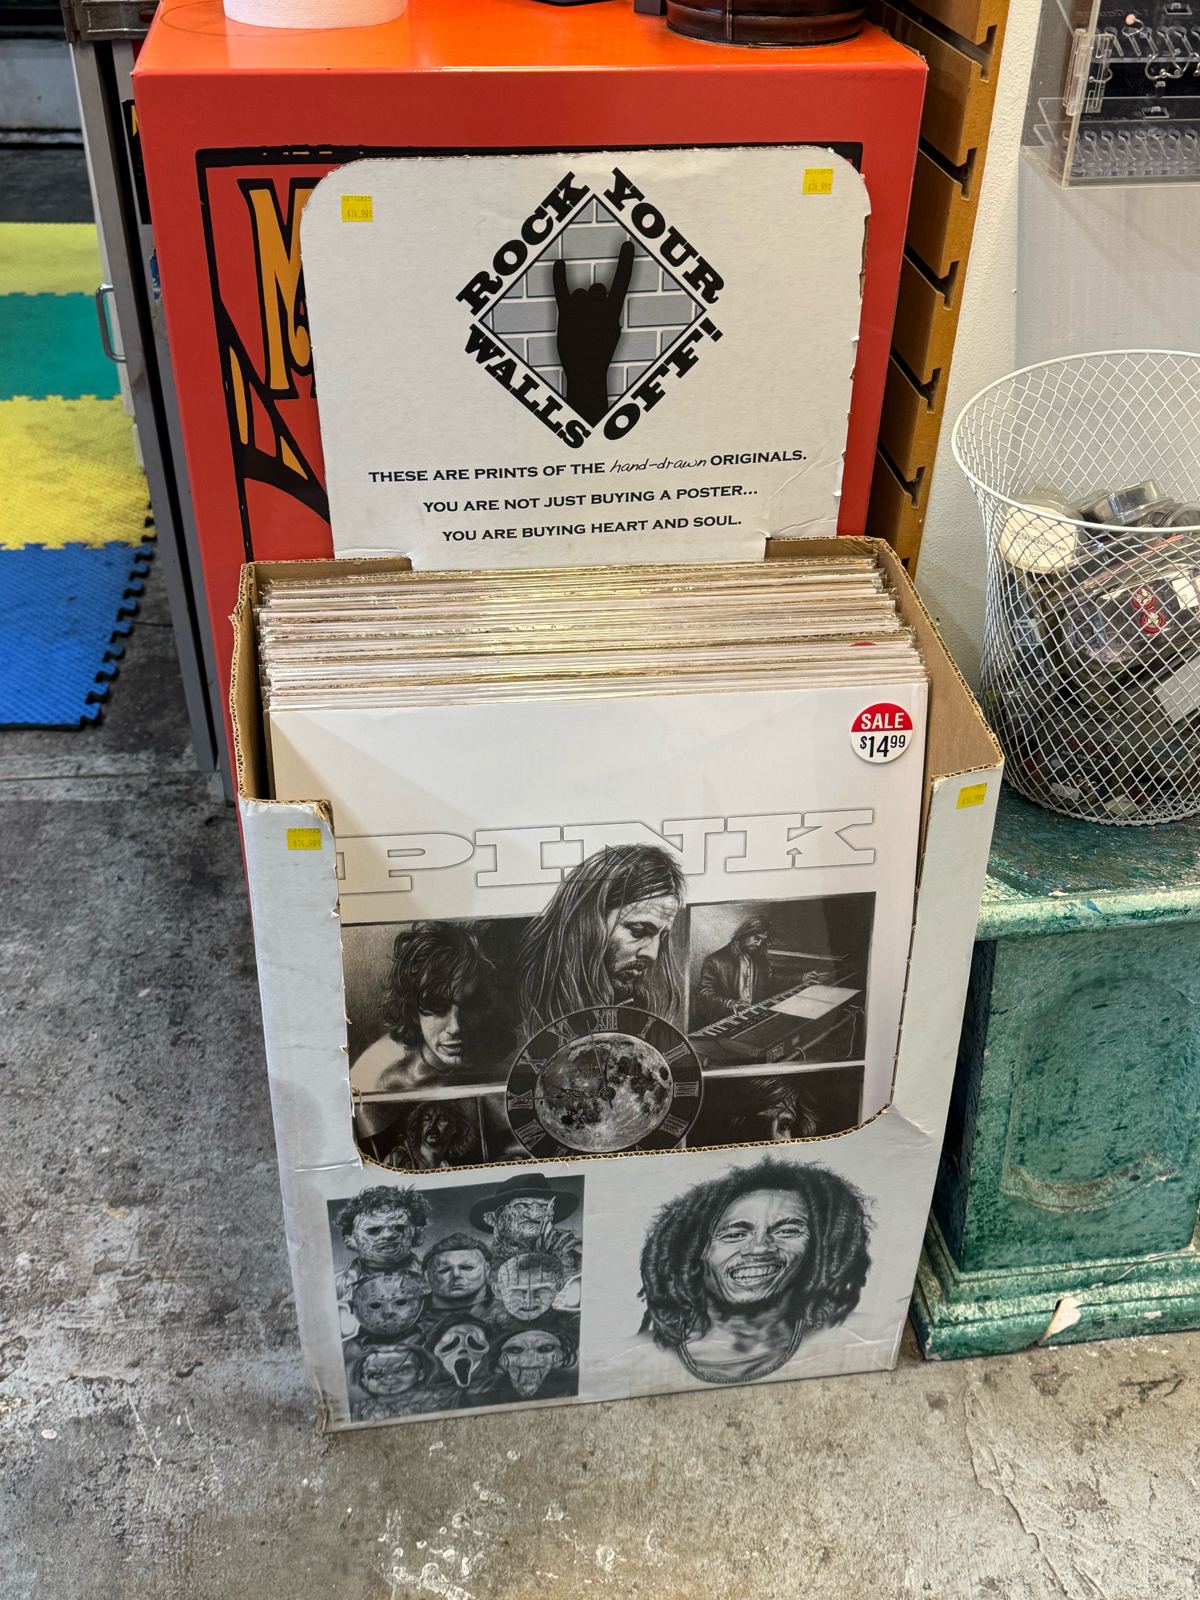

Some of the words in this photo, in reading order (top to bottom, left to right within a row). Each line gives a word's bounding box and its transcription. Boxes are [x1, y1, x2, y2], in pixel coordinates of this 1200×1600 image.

[455, 171, 590, 316] ROCK
[603, 167, 724, 304] YOUR
[464, 323, 591, 448] WALLS
[368, 470, 428, 483] THESE
[433, 469, 470, 481] ARE
[474, 466, 538, 480] PRINTS
[543, 464, 567, 477] OF
[571, 462, 605, 475] THE
[610, 456, 707, 474] hand-drawn
[710, 450, 807, 466] ORIGINALS.
[423, 501, 458, 513] YOU
[463, 500, 500, 512] ARE
[504, 498, 540, 510] NOT
[543, 495, 587, 508] JUST
[591, 491, 655, 505] BUYING
[659, 490, 672, 501] A
[676, 485, 758, 500] POSTER...
[442, 530, 477, 542] YOU
[482, 528, 517, 540] ARE
[522, 524, 586, 538] BUYING
[591, 520, 648, 533] HEART
[652, 518, 689, 530] AND
[693, 515, 742, 528] SOUL.
[860, 712, 905, 730] SALE
[335, 808, 875, 894] PINK
